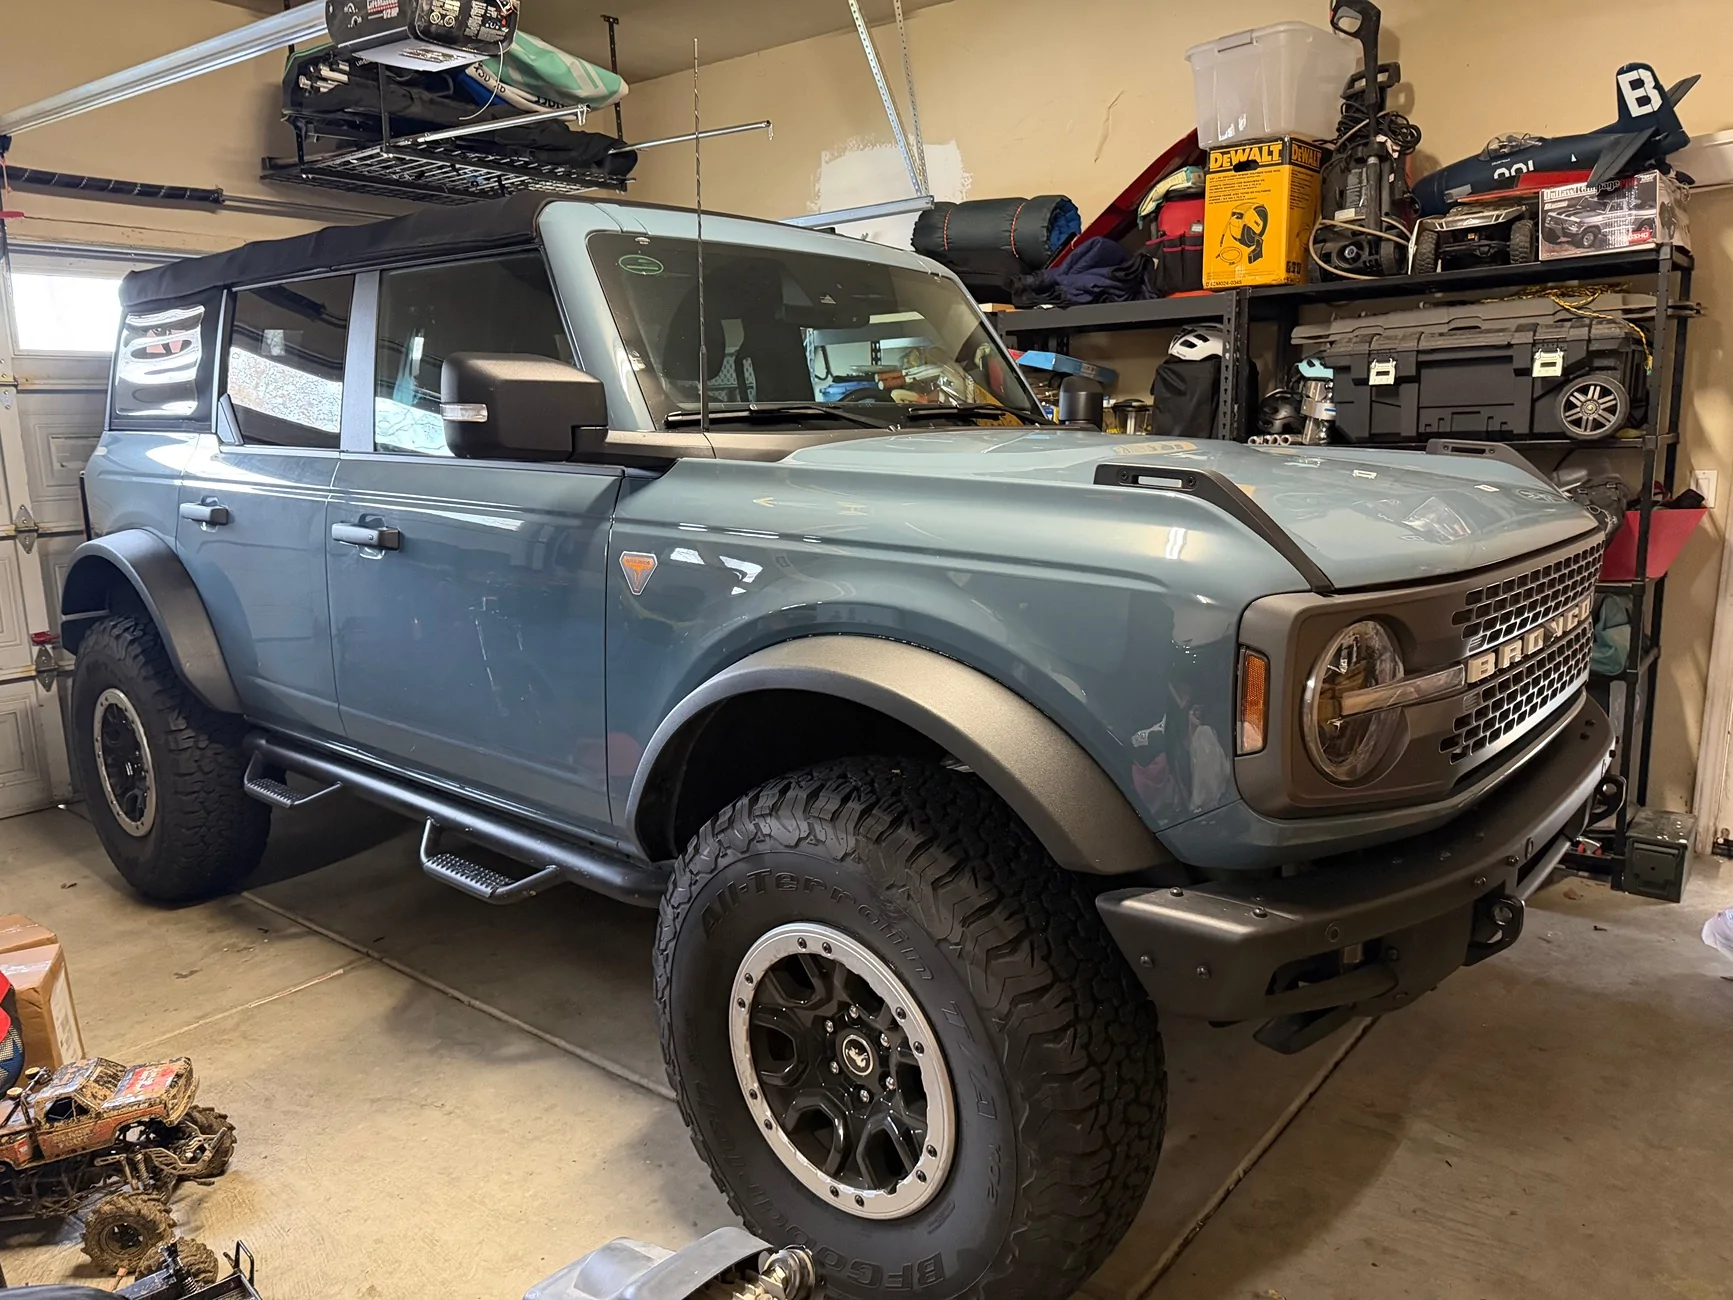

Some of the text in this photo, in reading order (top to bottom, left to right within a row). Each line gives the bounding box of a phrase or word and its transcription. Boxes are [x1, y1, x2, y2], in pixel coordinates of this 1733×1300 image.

[1618, 68, 1663, 118] B
[1467, 595, 1592, 684] BRONCO
[701, 867, 934, 981] All-Terrain
